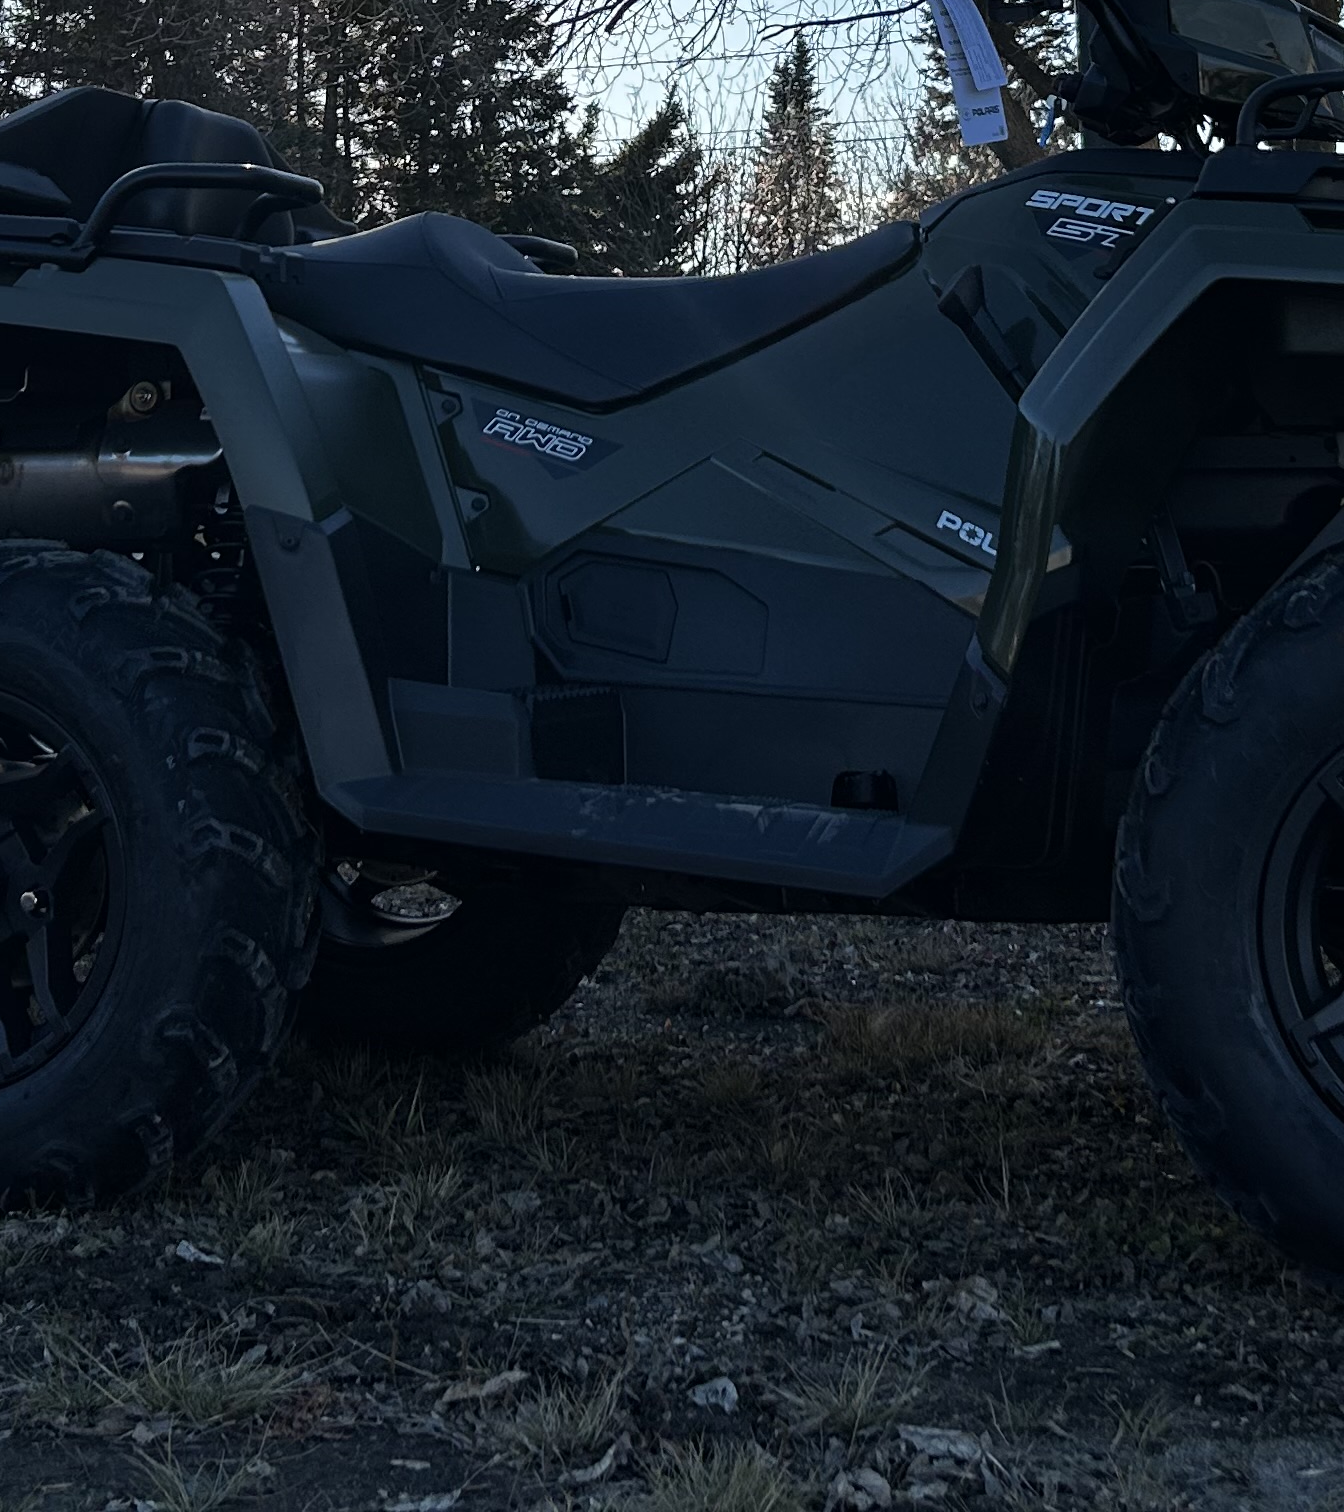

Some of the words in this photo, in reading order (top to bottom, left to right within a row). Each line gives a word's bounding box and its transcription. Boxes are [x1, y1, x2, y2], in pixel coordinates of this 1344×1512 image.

[971, 105, 1000, 116] POLARIS
[1024, 189, 1155, 226] SPORT
[482, 416, 587, 462] AWD
